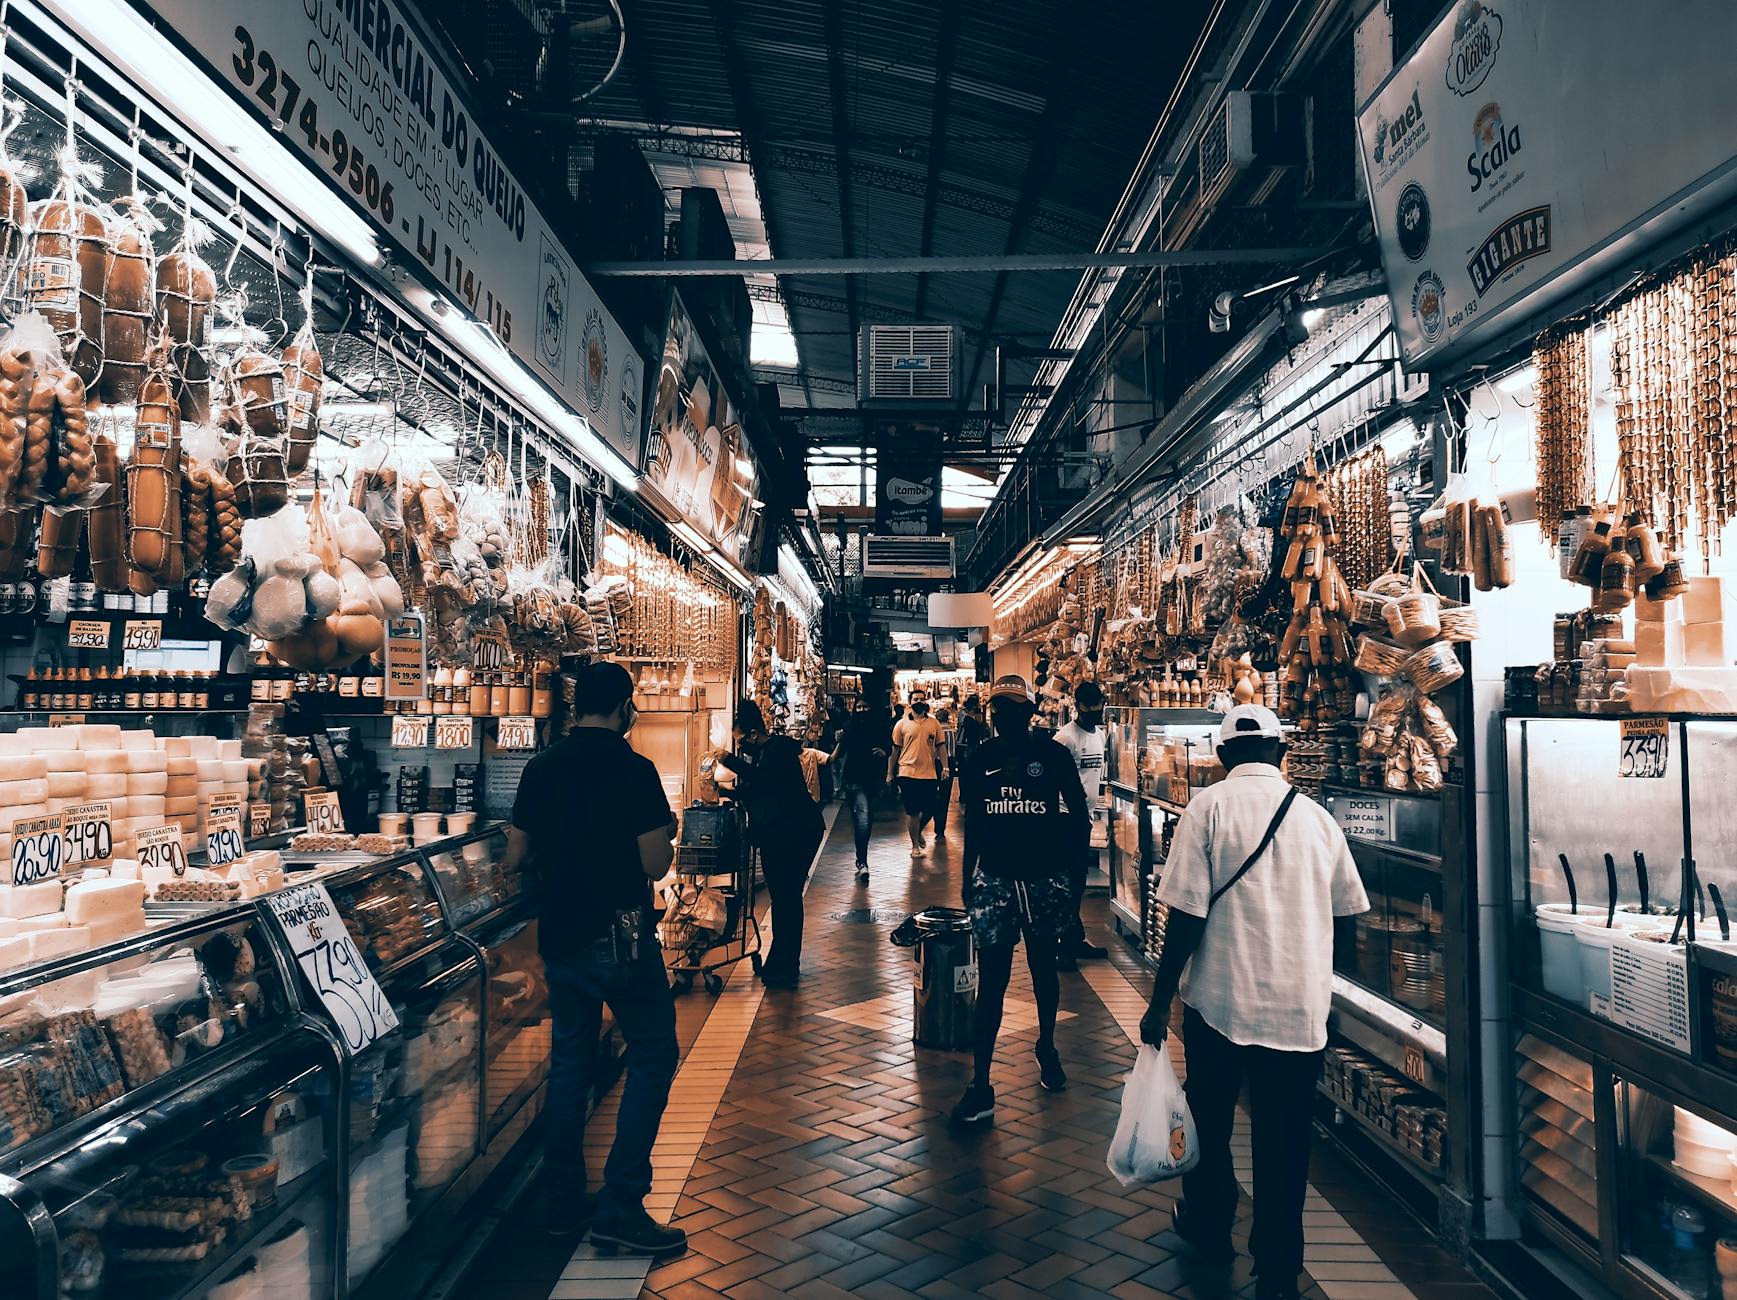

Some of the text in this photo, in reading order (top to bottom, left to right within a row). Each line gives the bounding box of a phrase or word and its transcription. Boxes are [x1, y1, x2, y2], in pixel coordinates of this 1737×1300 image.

[304, 0, 402, 128] QUALIDADE
[407, 112, 427, 157] EM
[445, 159, 483, 226] LUGAR
[1390, 89, 1422, 148] mel
[308, 39, 387, 158] QUEIJOS,
[393, 136, 444, 220] DOCES,
[232, 25, 394, 225] 3274-9506
[417, 214, 436, 267] LJ
[1389, 145, 1404, 163] Santa
[442, 88, 468, 168] DO
[474, 137, 525, 242] QUEIJO
[1467, 124, 1522, 192] Scala
[1472, 216, 1546, 290] GIGANTE
[1447, 299, 1479, 329] Loja 193
[894, 485, 928, 495] itambé
[391, 671, 401, 680] R$
[1624, 718, 1664, 729] PARMESÃO
[1001, 786, 1022, 800] Fly
[80, 805, 108, 813] CANASTRA
[1350, 801, 1379, 809] DOCES
[29, 820, 48, 832] CANASTRA
[152, 827, 178, 837] CANASTRA
[278, 902, 330, 928] PARMESÃO
